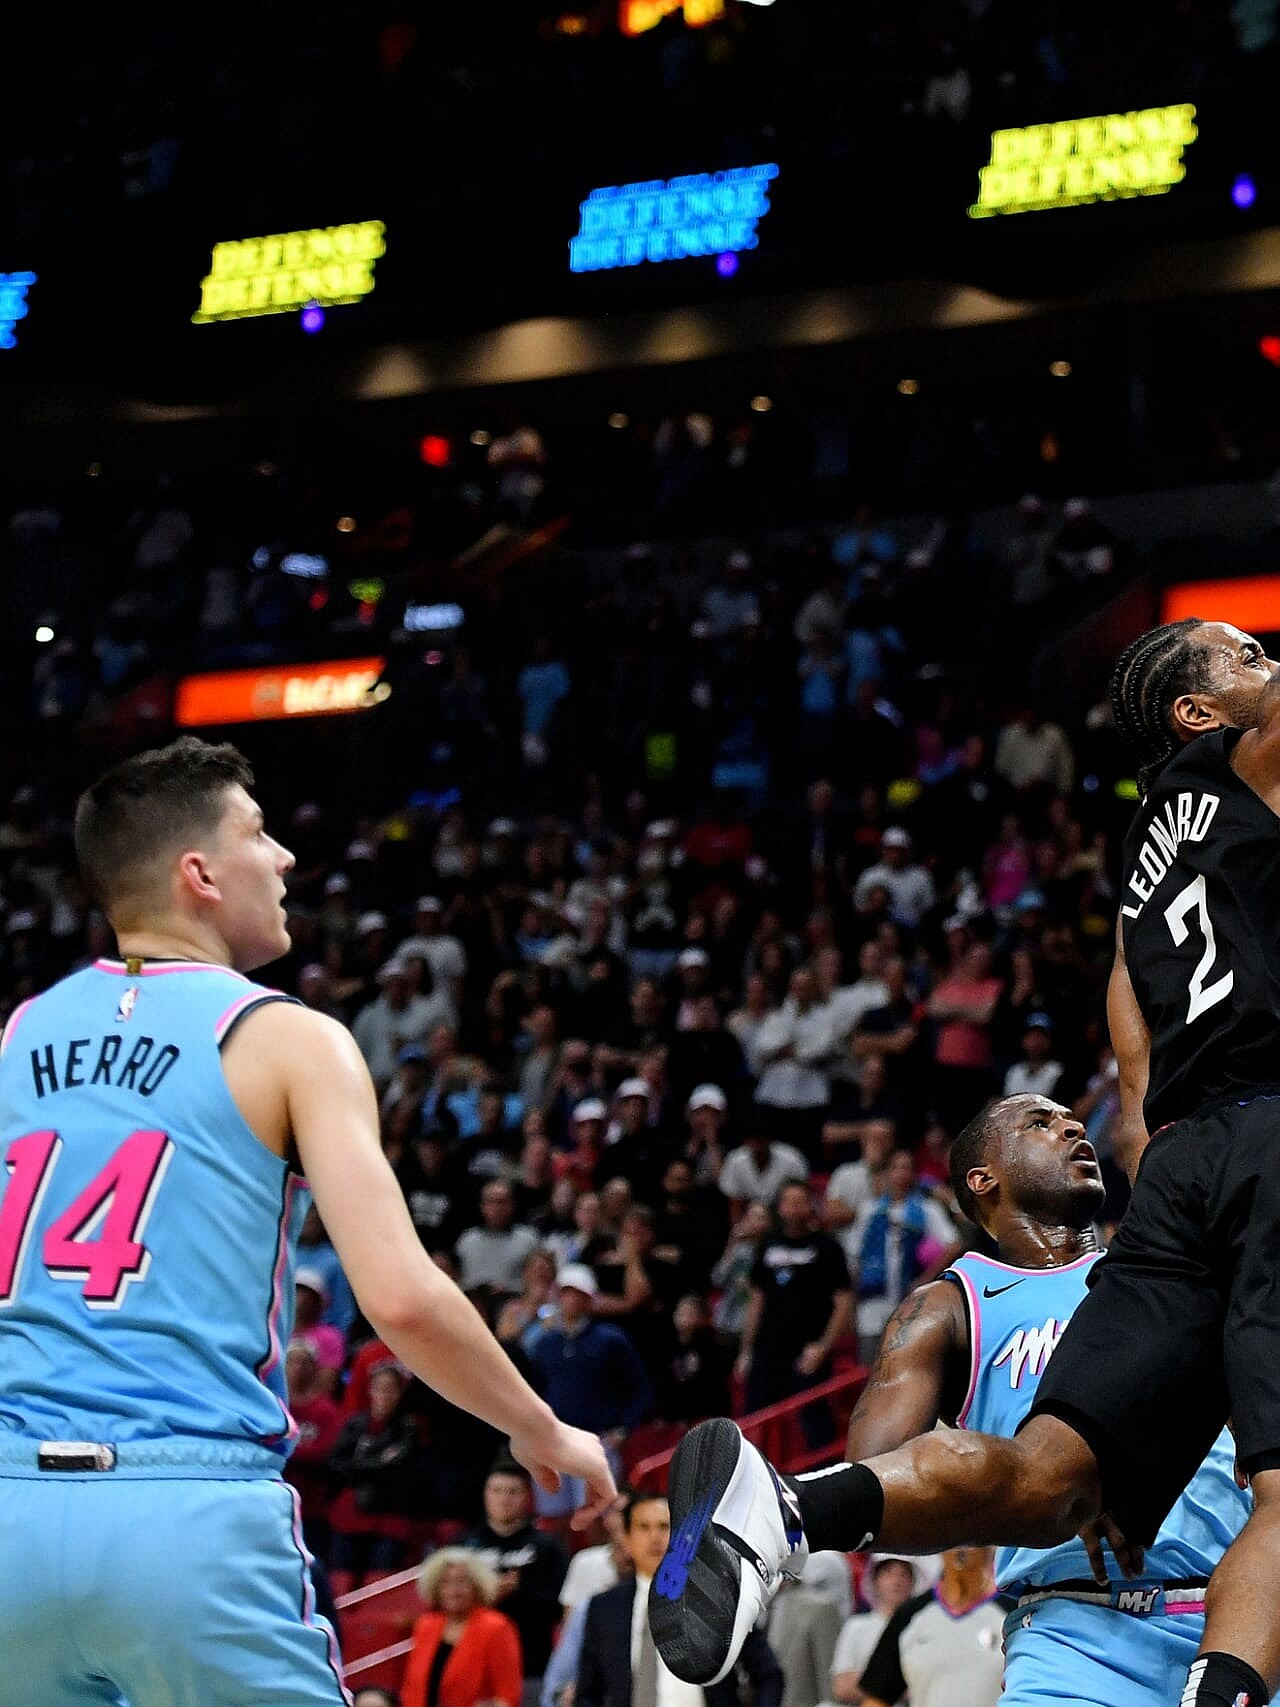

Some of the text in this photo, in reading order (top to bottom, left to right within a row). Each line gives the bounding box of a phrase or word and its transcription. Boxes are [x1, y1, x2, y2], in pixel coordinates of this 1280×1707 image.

[1163, 873, 1234, 1025] 2
[30, 1034, 180, 1099] HERRO
[0, 1130, 177, 1311] 14
